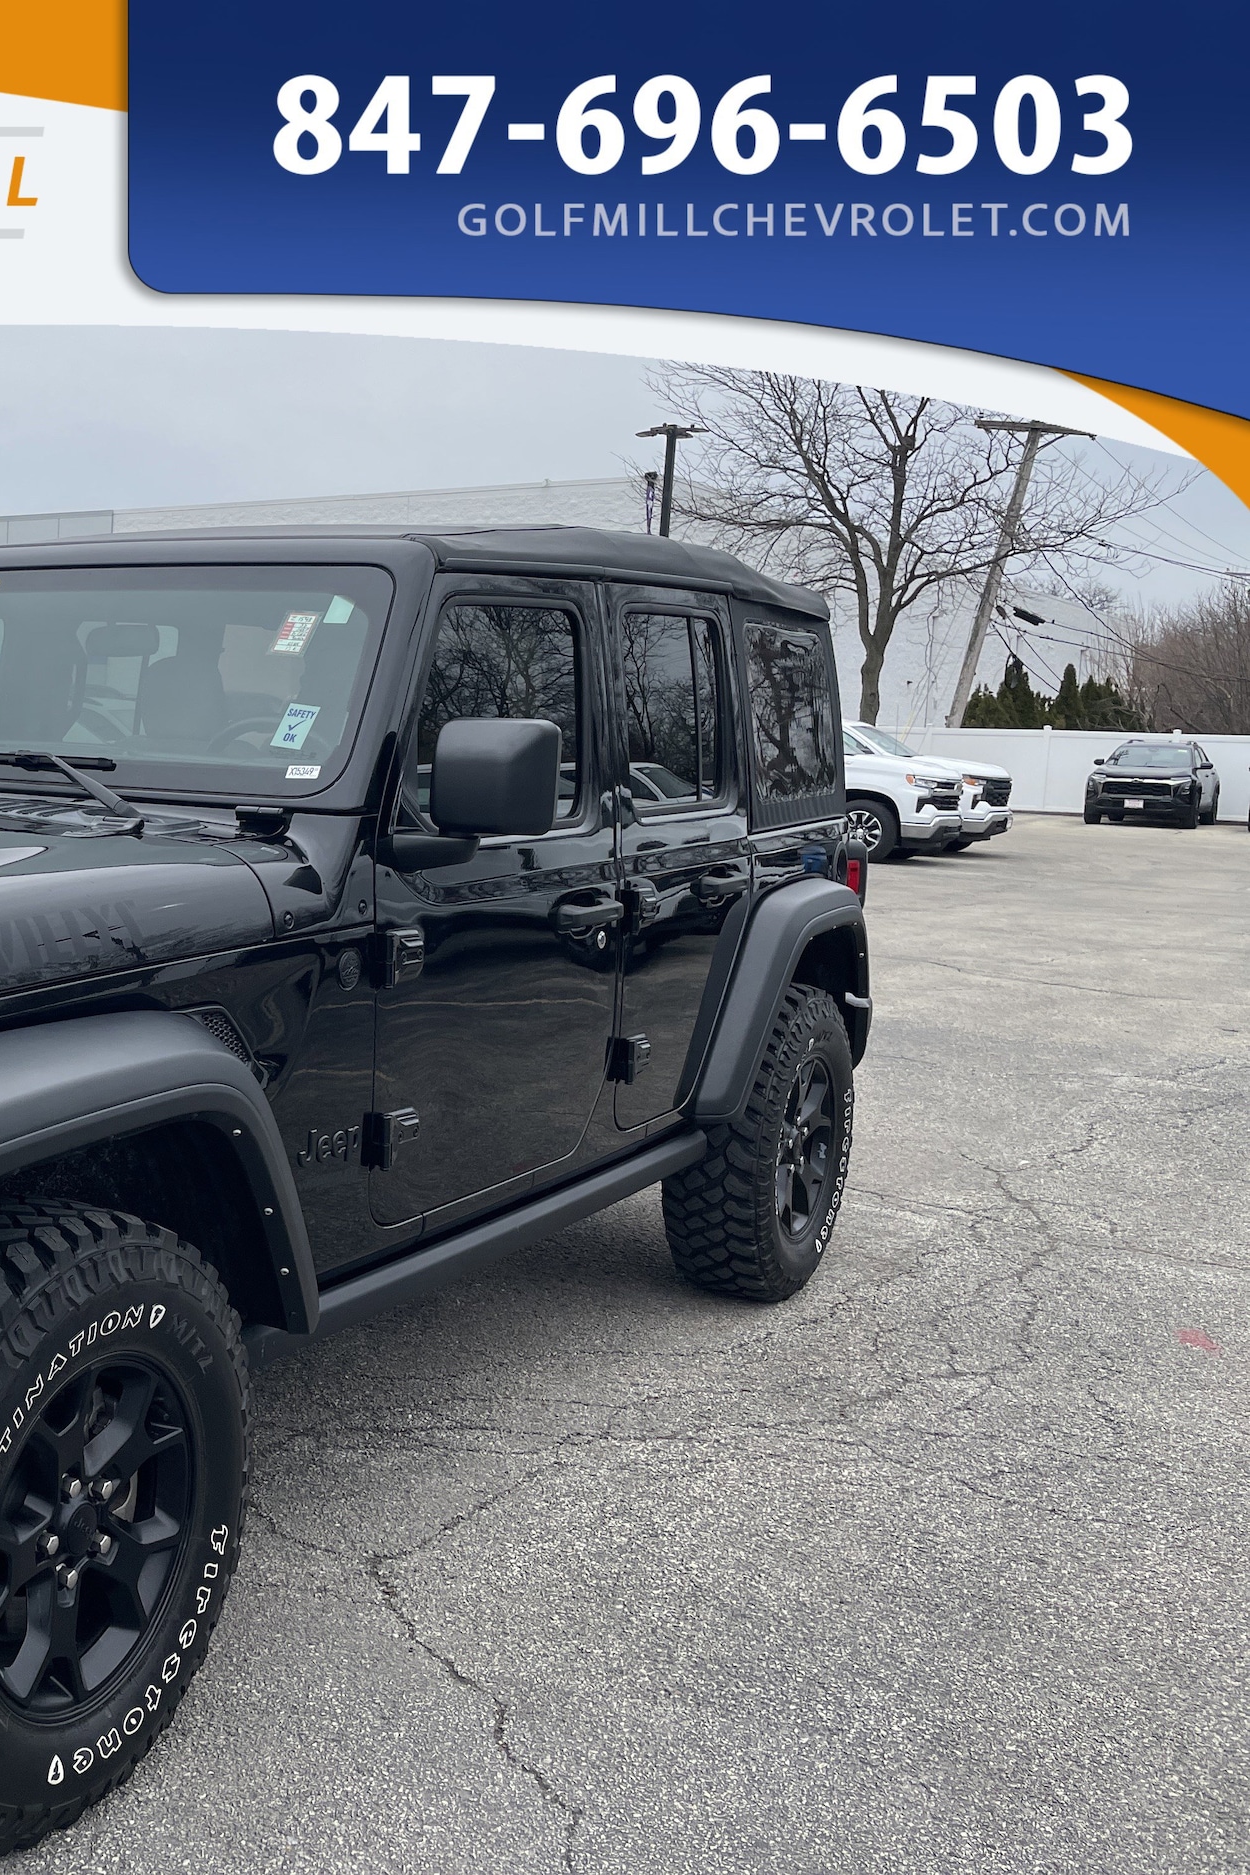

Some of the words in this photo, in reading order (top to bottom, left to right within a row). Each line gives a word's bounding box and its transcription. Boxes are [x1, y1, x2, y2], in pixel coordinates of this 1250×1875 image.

[287, 708, 316, 720] SAFETY
[283, 732, 297, 743] OK
[297, 1125, 360, 1168] Jeep
